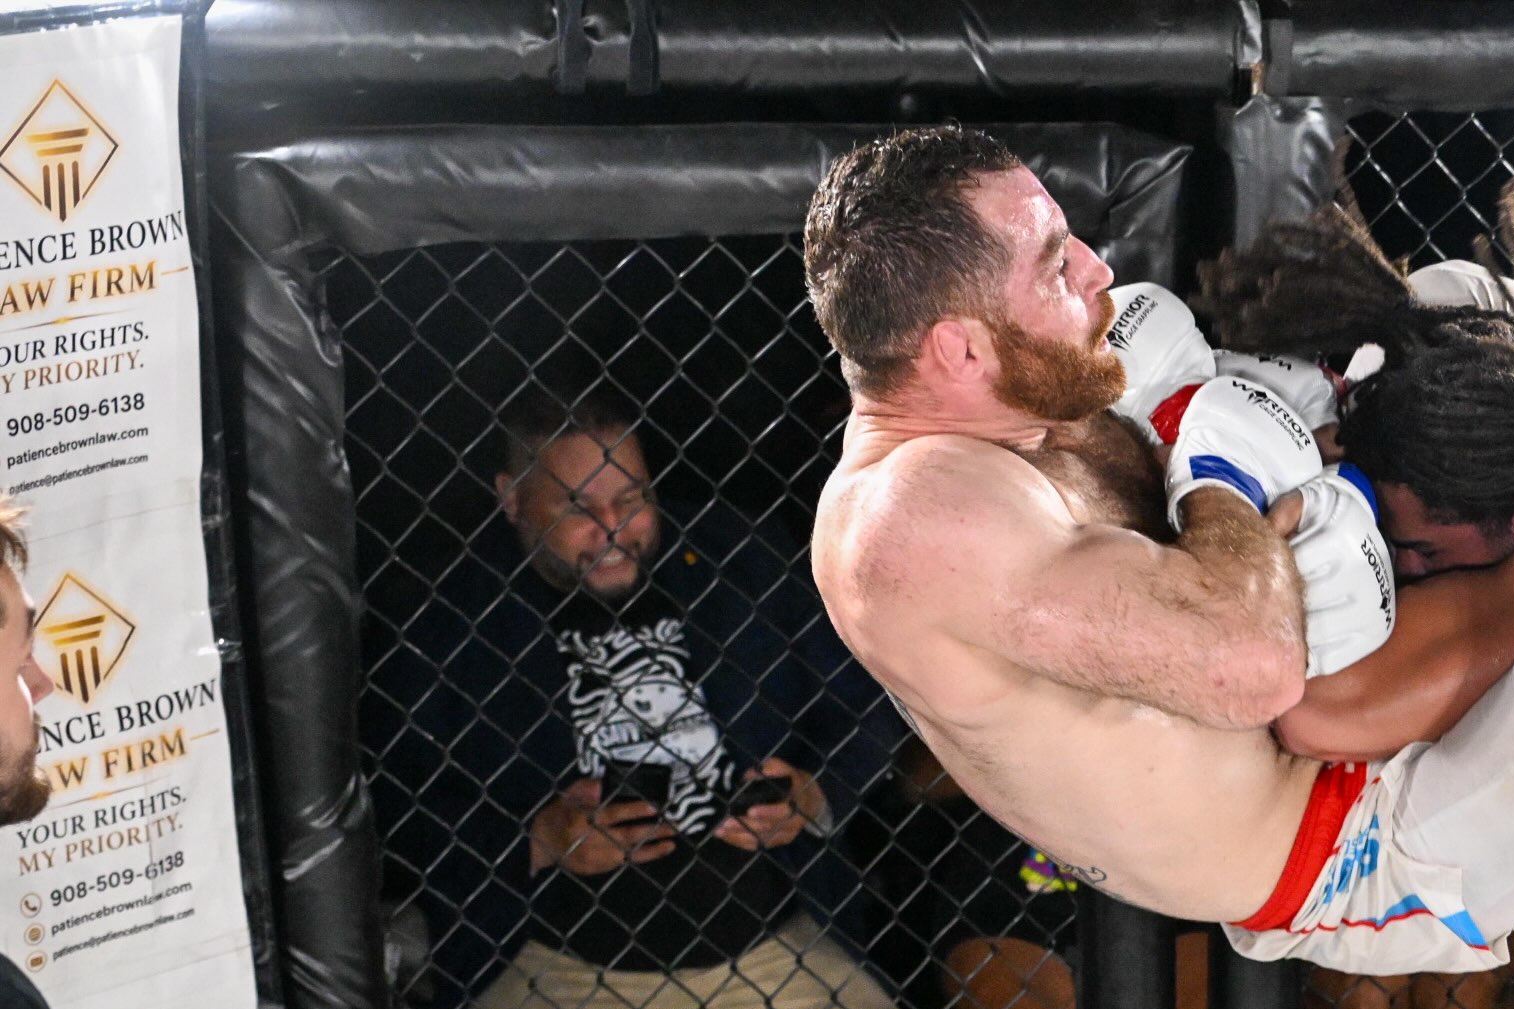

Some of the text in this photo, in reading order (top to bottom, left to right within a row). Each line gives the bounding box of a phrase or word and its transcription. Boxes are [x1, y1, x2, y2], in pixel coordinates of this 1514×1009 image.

[88, 210, 184, 257] BROWN
[67, 260, 158, 304] FIRM
[54, 321, 150, 356] RIGHTS.
[24, 349, 145, 390] PRIORITY.
[7, 392, 146, 436] 908-509-6138
[7, 427, 149, 469] patiencebrownlaw.com
[115, 678, 216, 733] BROWN
[101, 726, 188, 780] FIRM
[17, 786, 187, 849] YOUR RIGHTS.
[19, 811, 183, 877] MY PRIORITY.
[50, 850, 185, 907] 908-509-6138
[51, 881, 193, 936] patiencebrownlaw.com
